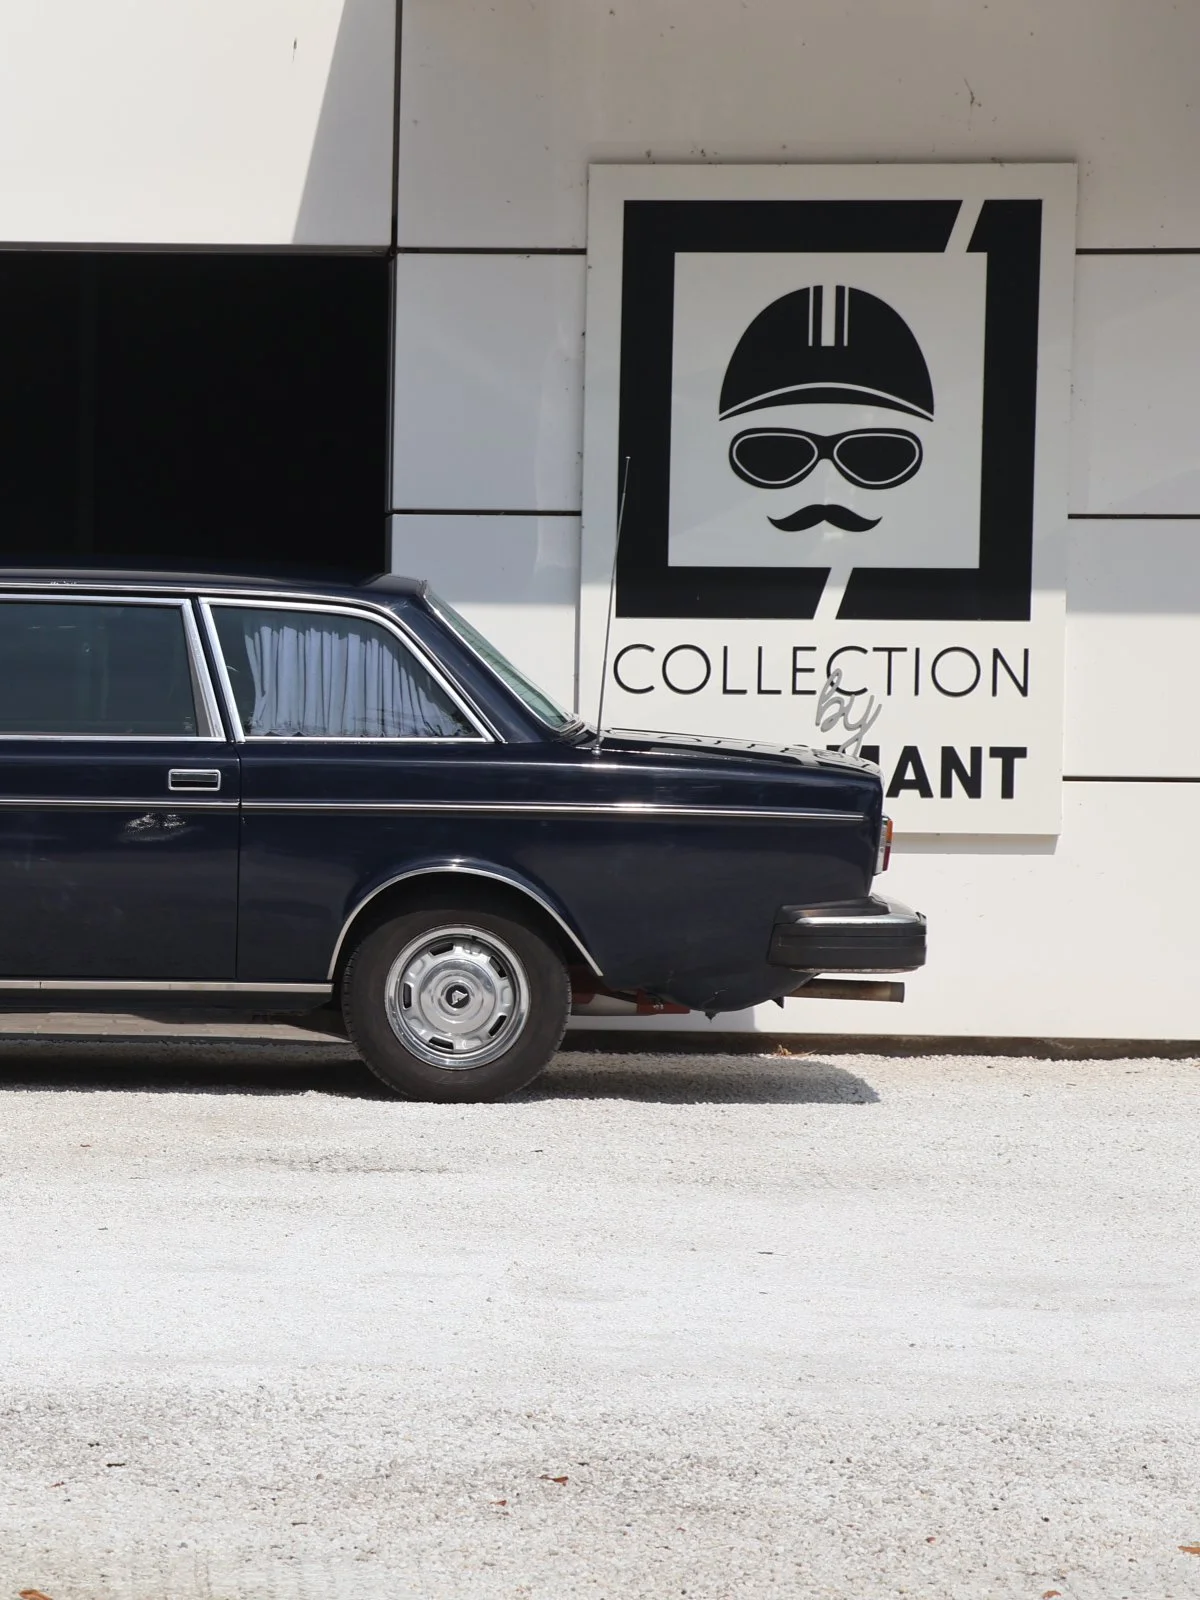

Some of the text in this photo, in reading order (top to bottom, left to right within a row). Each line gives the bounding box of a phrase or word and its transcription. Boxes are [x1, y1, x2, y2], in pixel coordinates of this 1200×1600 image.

[613, 643, 1030, 698] COLLECTION
[815, 668, 882, 758] by
[826, 745, 1028, 799] ANT
